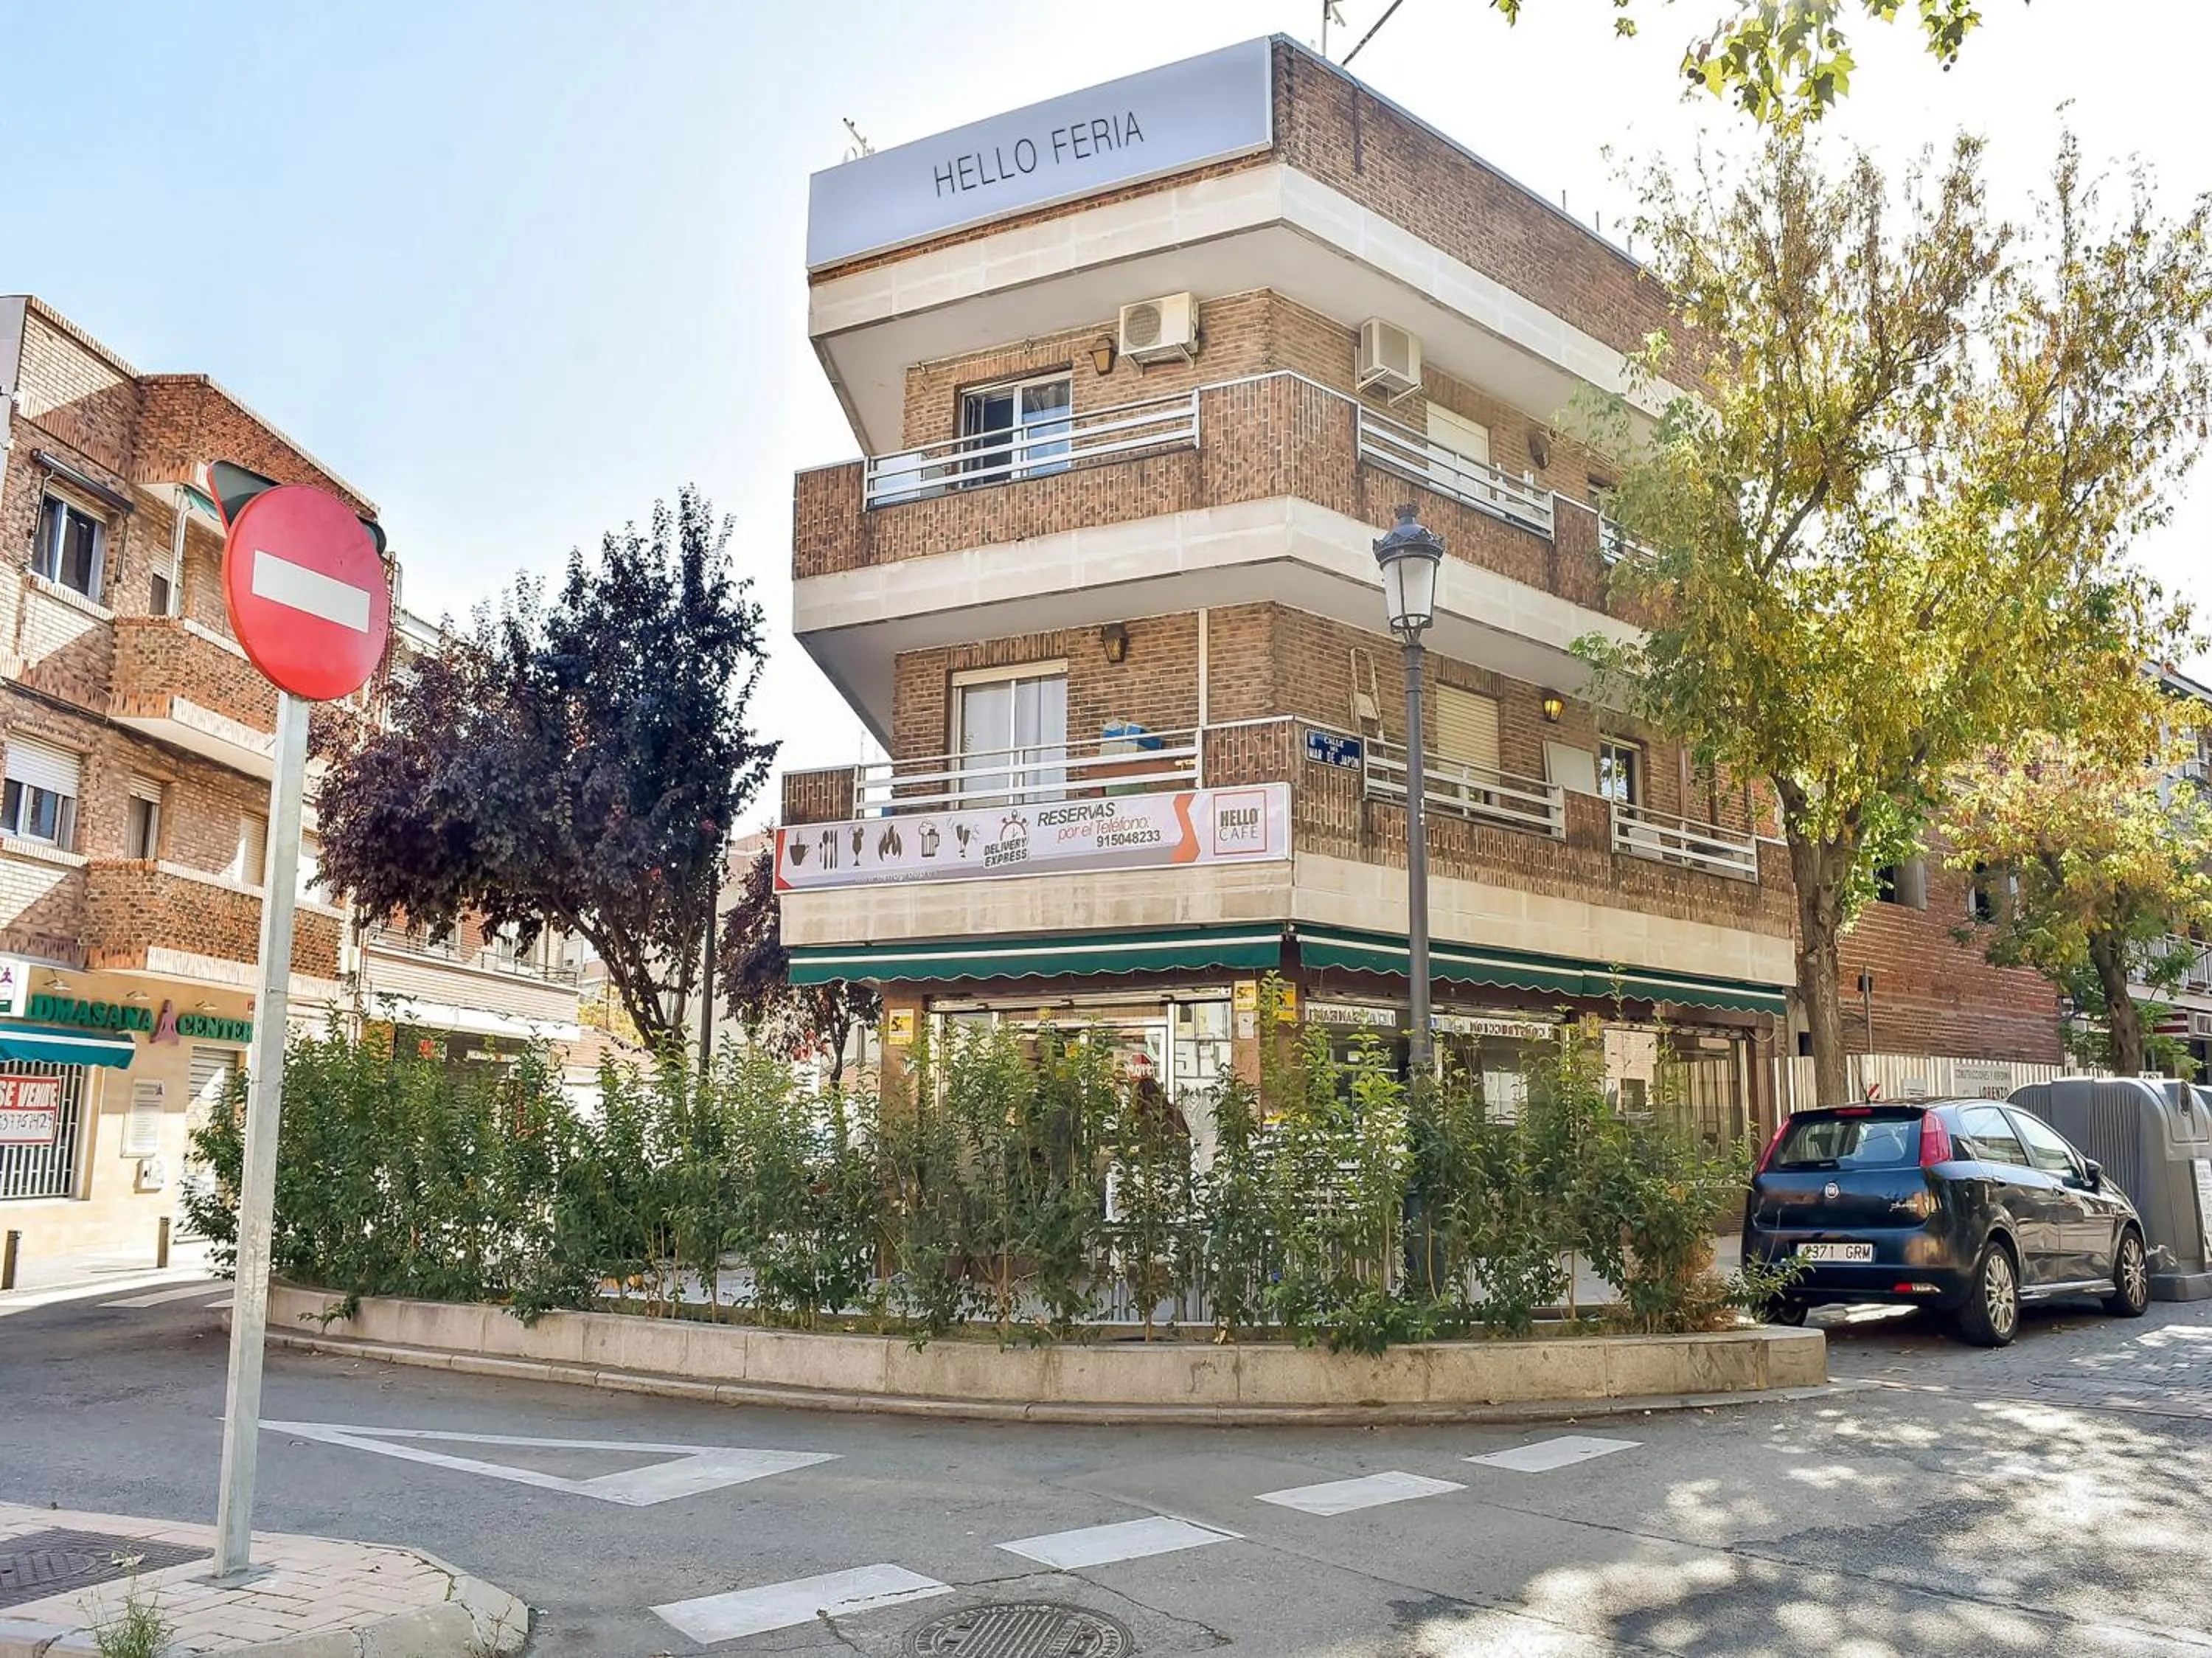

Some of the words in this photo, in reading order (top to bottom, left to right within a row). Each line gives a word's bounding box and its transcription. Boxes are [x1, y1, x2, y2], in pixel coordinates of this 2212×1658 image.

[933, 139, 1037, 197] HELLO
[1051, 111, 1144, 164] FERIA
[1324, 736, 1344, 749] CALLE
[1309, 747, 1323, 760] MAR
[1326, 751, 1335, 764] DE
[1037, 802, 1116, 827] RESERVAS
[1220, 808, 1259, 827] HELLO
[1057, 827, 1080, 844] por
[1082, 822, 1093, 838] el
[1096, 830, 1161, 848] 915048233
[1219, 826, 1259, 842] CAFE
[984, 836, 1027, 856] DELIVERY
[984, 848, 1028, 867] EXPRESS
[17, 1082, 58, 1107] VENDE
[1846, 1245, 1871, 1260] GRM
